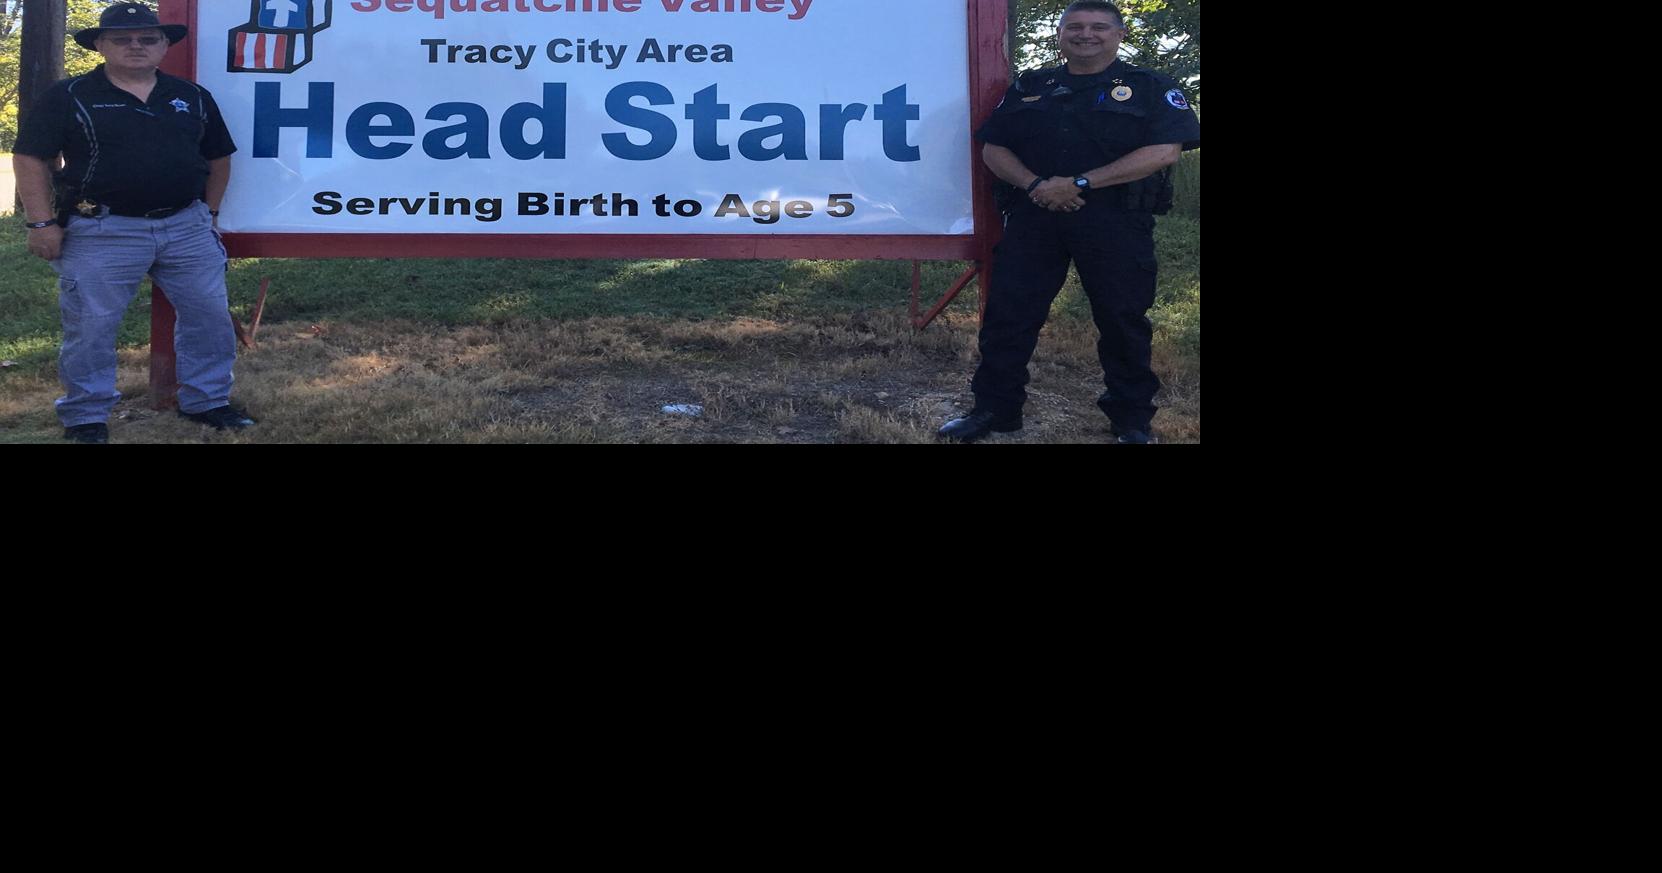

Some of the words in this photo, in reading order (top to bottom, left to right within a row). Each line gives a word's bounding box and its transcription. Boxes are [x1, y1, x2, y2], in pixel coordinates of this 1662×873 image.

[421, 39, 536, 69] Tracy
[547, 39, 627, 69] City
[637, 39, 733, 63] Area
[252, 81, 567, 160] Head
[601, 81, 920, 162] Start
[312, 191, 502, 222] Serving
[517, 192, 638, 217] Birth
[652, 194, 702, 218] to
[713, 193, 814, 224] Age
[826, 193, 855, 218] 5
